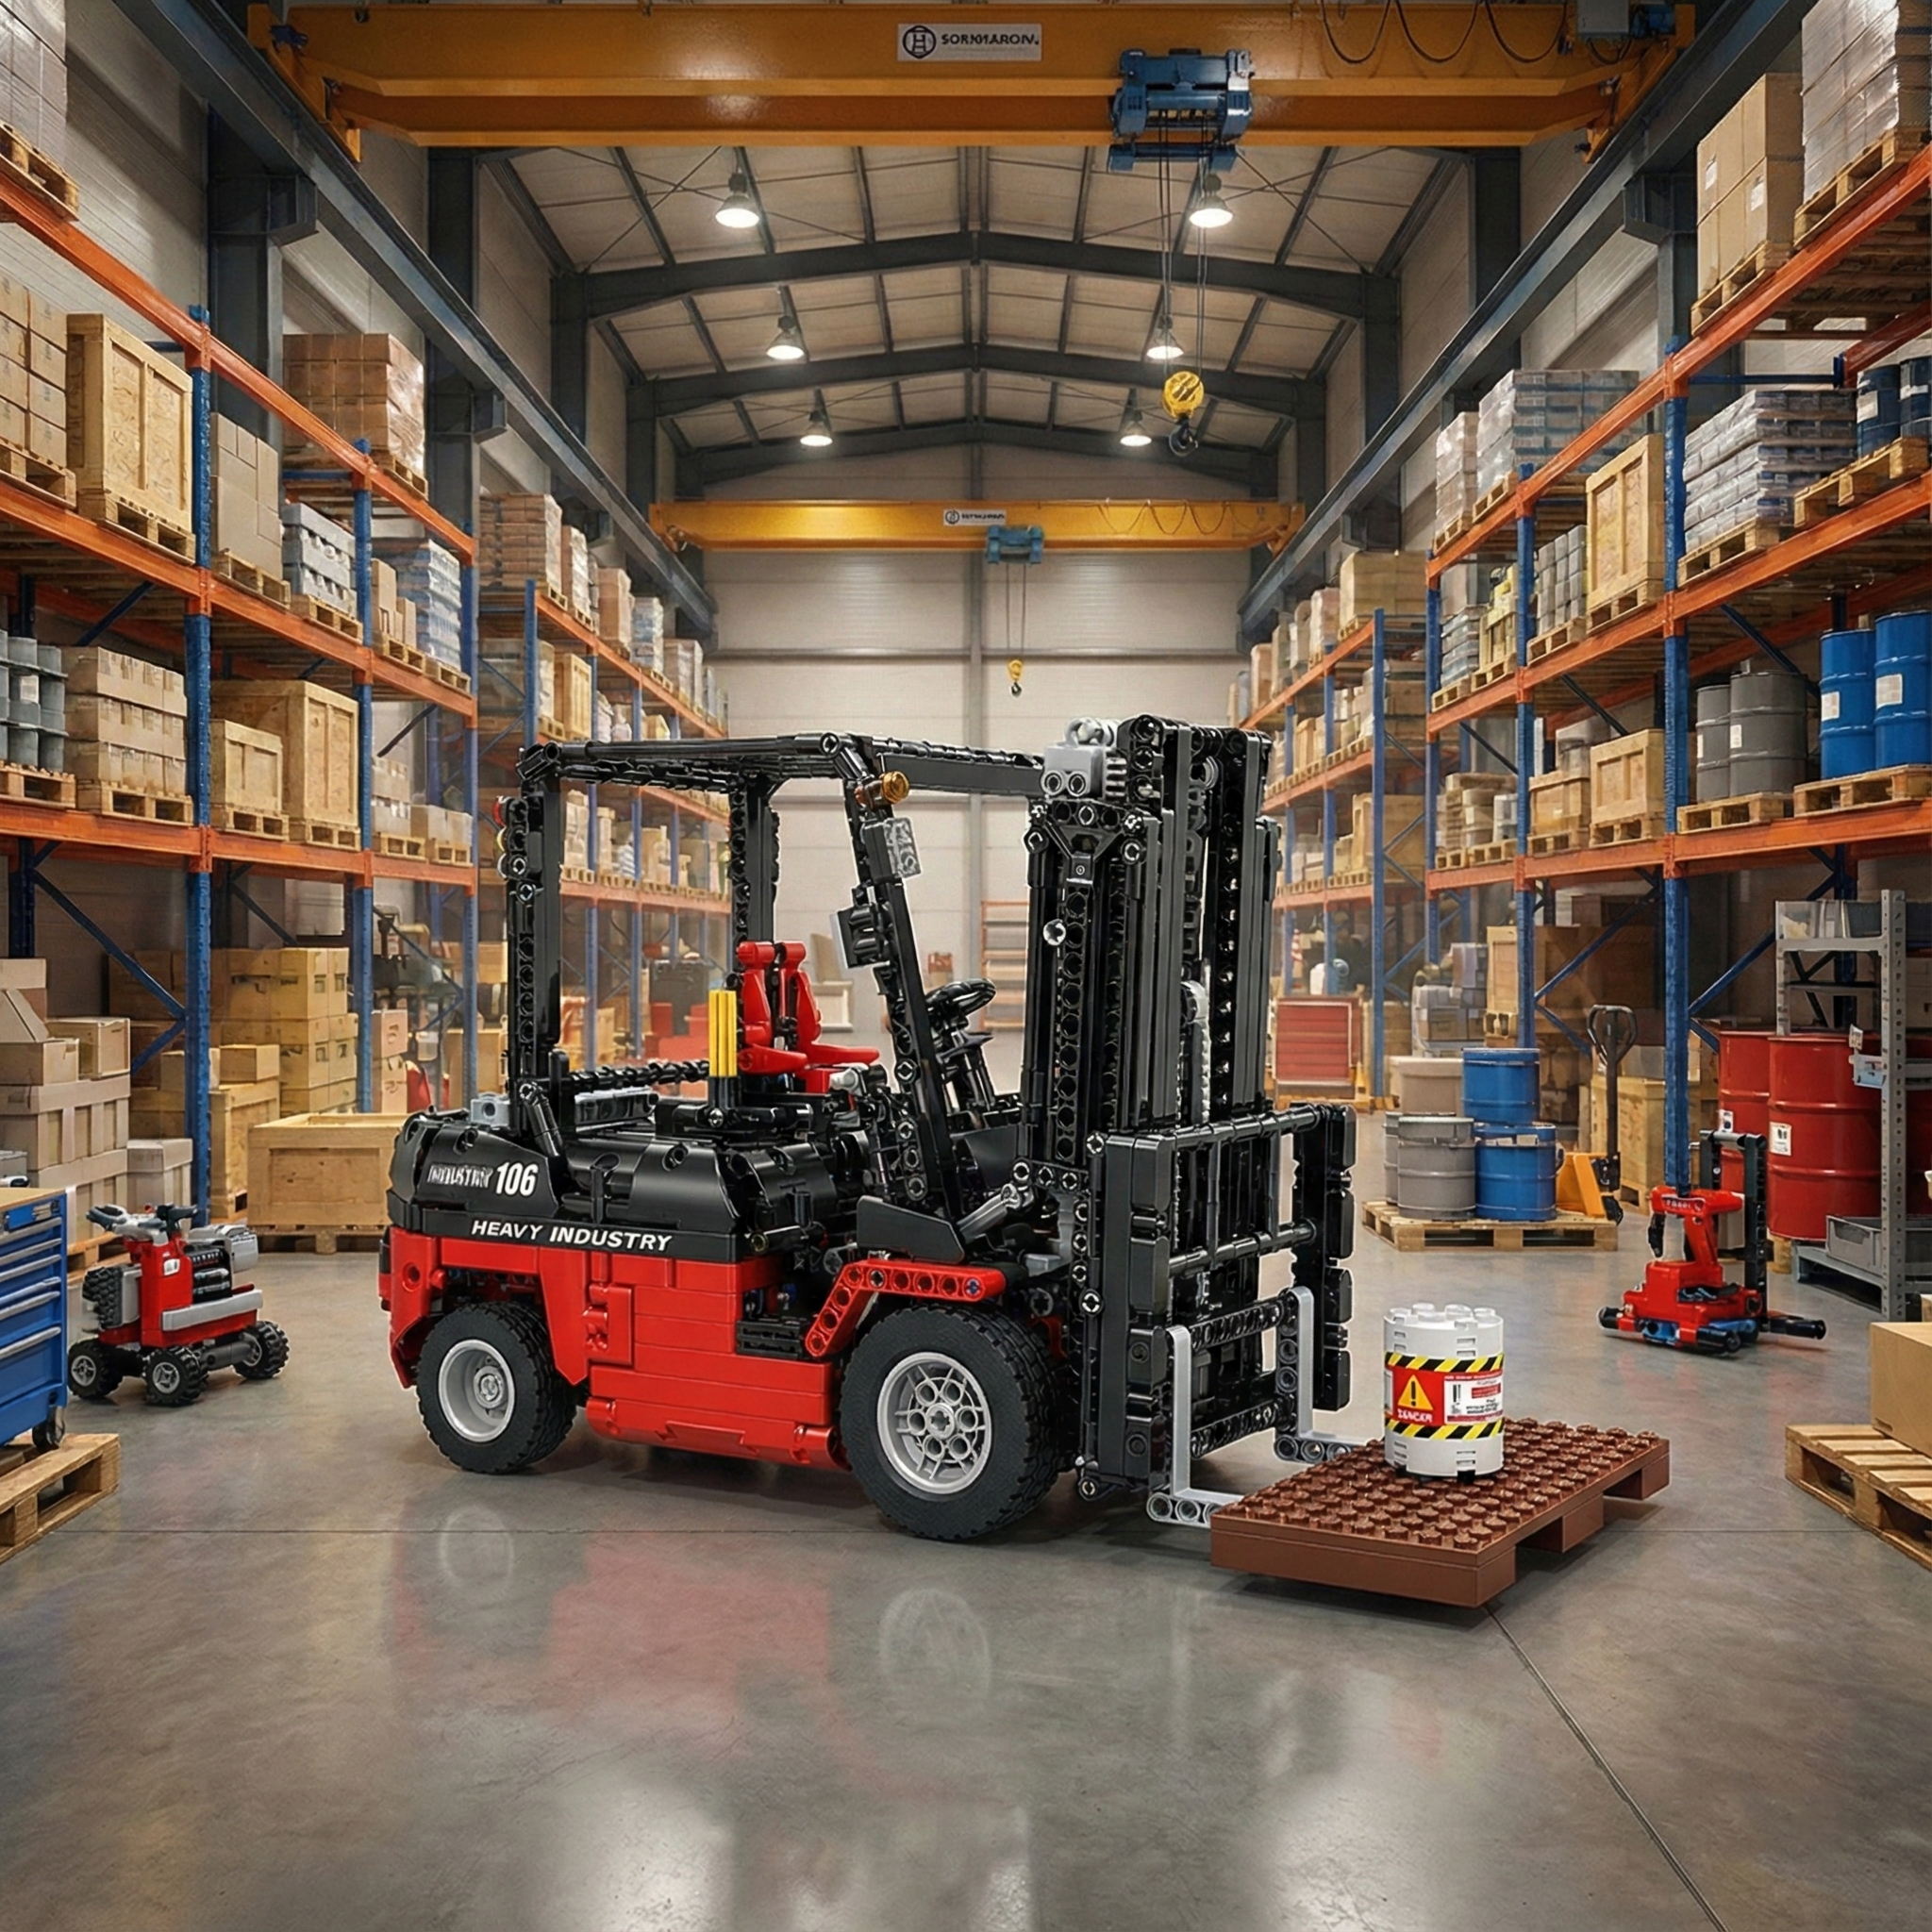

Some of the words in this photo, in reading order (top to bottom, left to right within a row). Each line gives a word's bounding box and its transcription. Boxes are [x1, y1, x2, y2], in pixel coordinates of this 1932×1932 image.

[496, 1161, 539, 1196] 106
[472, 1221, 543, 1241] HEAVY
[550, 1226, 673, 1252] INDUSTRY
